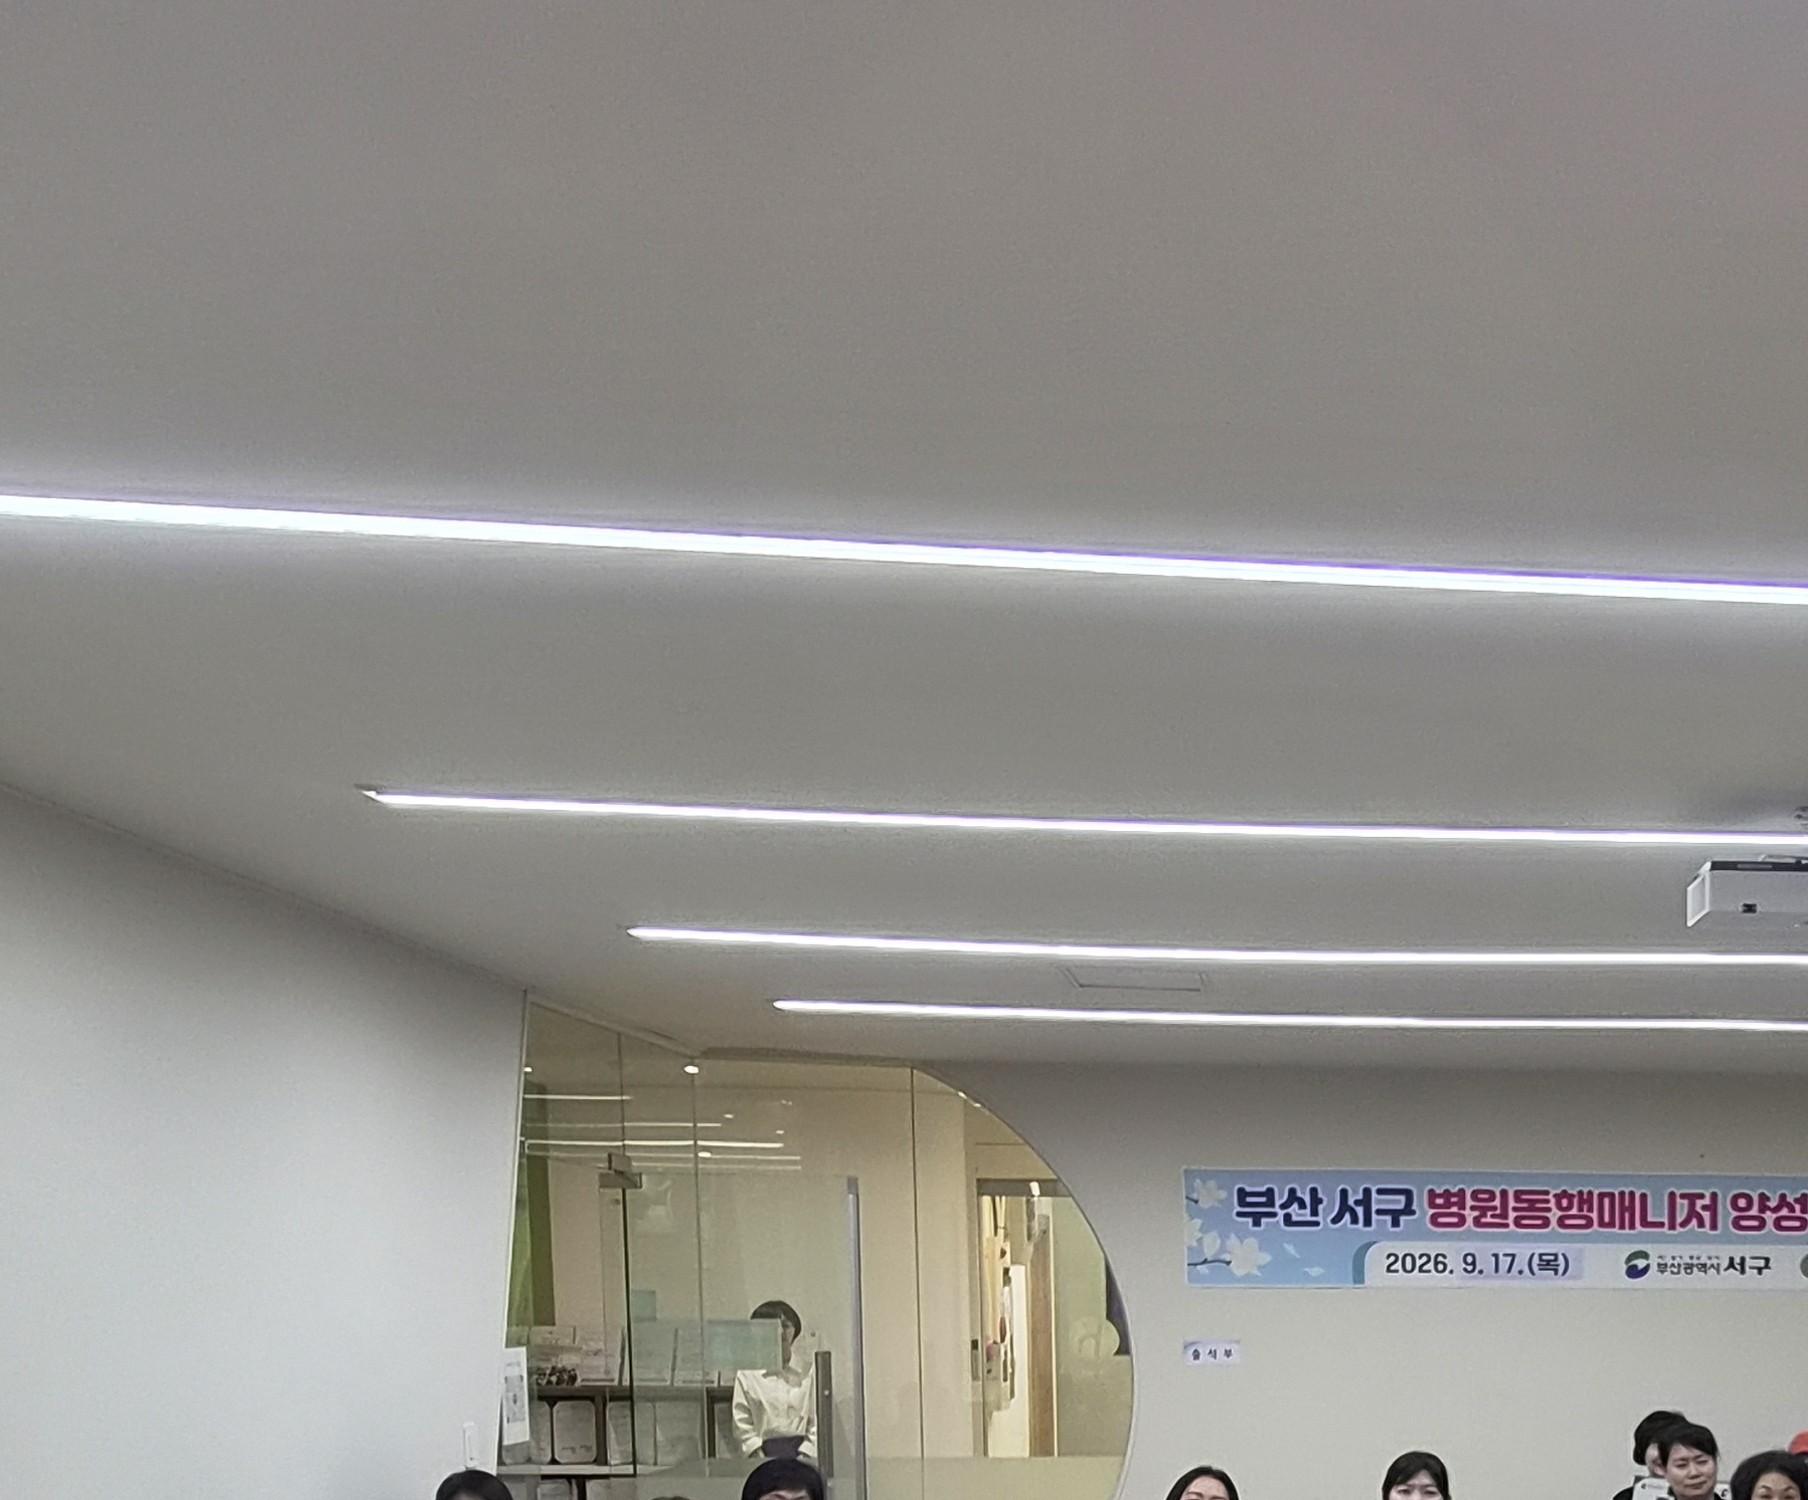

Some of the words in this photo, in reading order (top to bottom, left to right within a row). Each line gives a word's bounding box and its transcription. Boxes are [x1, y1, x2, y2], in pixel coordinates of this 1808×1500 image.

[1235, 1186, 1324, 1228] 부산
[1330, 1186, 1417, 1229] 서구
[1427, 1187, 1719, 1232] 병원동행매니저
[1729, 1191, 1808, 1232] 양성
[1385, 1252, 1454, 1275] 2026.
[1462, 1252, 1484, 1276] 9.
[1656, 1262, 1721, 1276] 부산광역시
[1723, 1255, 1772, 1276] 서구
